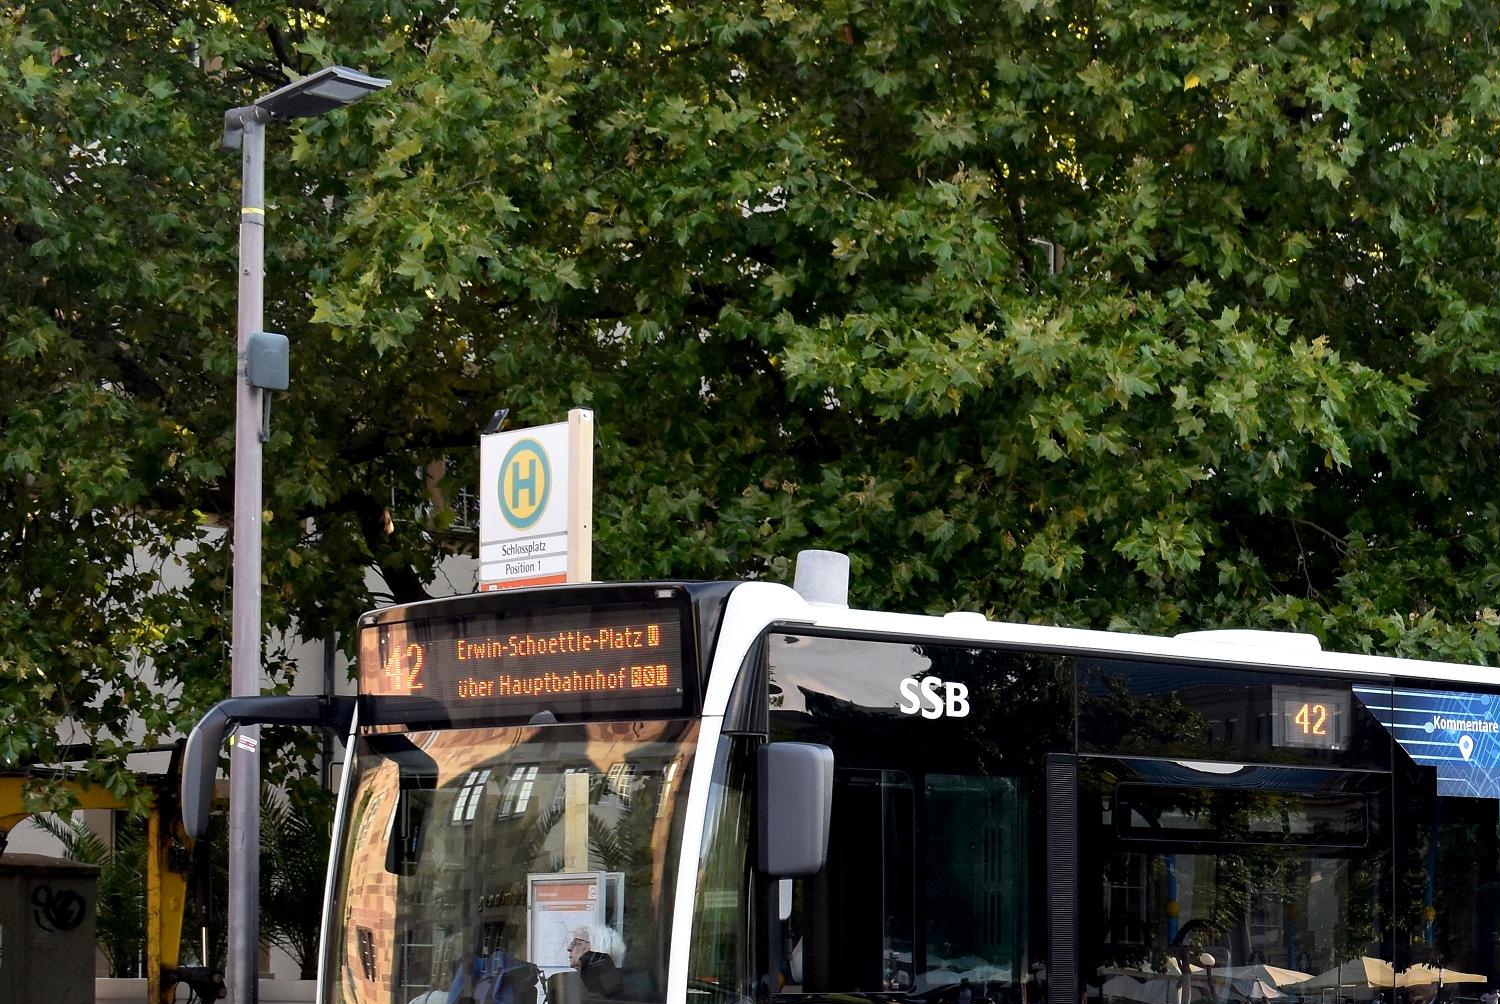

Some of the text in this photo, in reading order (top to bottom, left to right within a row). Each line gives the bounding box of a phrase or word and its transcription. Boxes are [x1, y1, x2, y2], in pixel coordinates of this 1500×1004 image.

[513, 459, 536, 508] H
[502, 541, 546, 557] Schlossplatz
[506, 561, 541, 574] Position 1
[458, 626, 643, 660] Erwin-Schoettle-Platz
[384, 643, 424, 689] 42
[458, 678, 494, 698] über
[500, 667, 625, 696] Hauptbahnhof
[899, 676, 970, 720] SSB
[1294, 704, 1327, 736] 42
[1433, 715, 1499, 733] Kommentare
